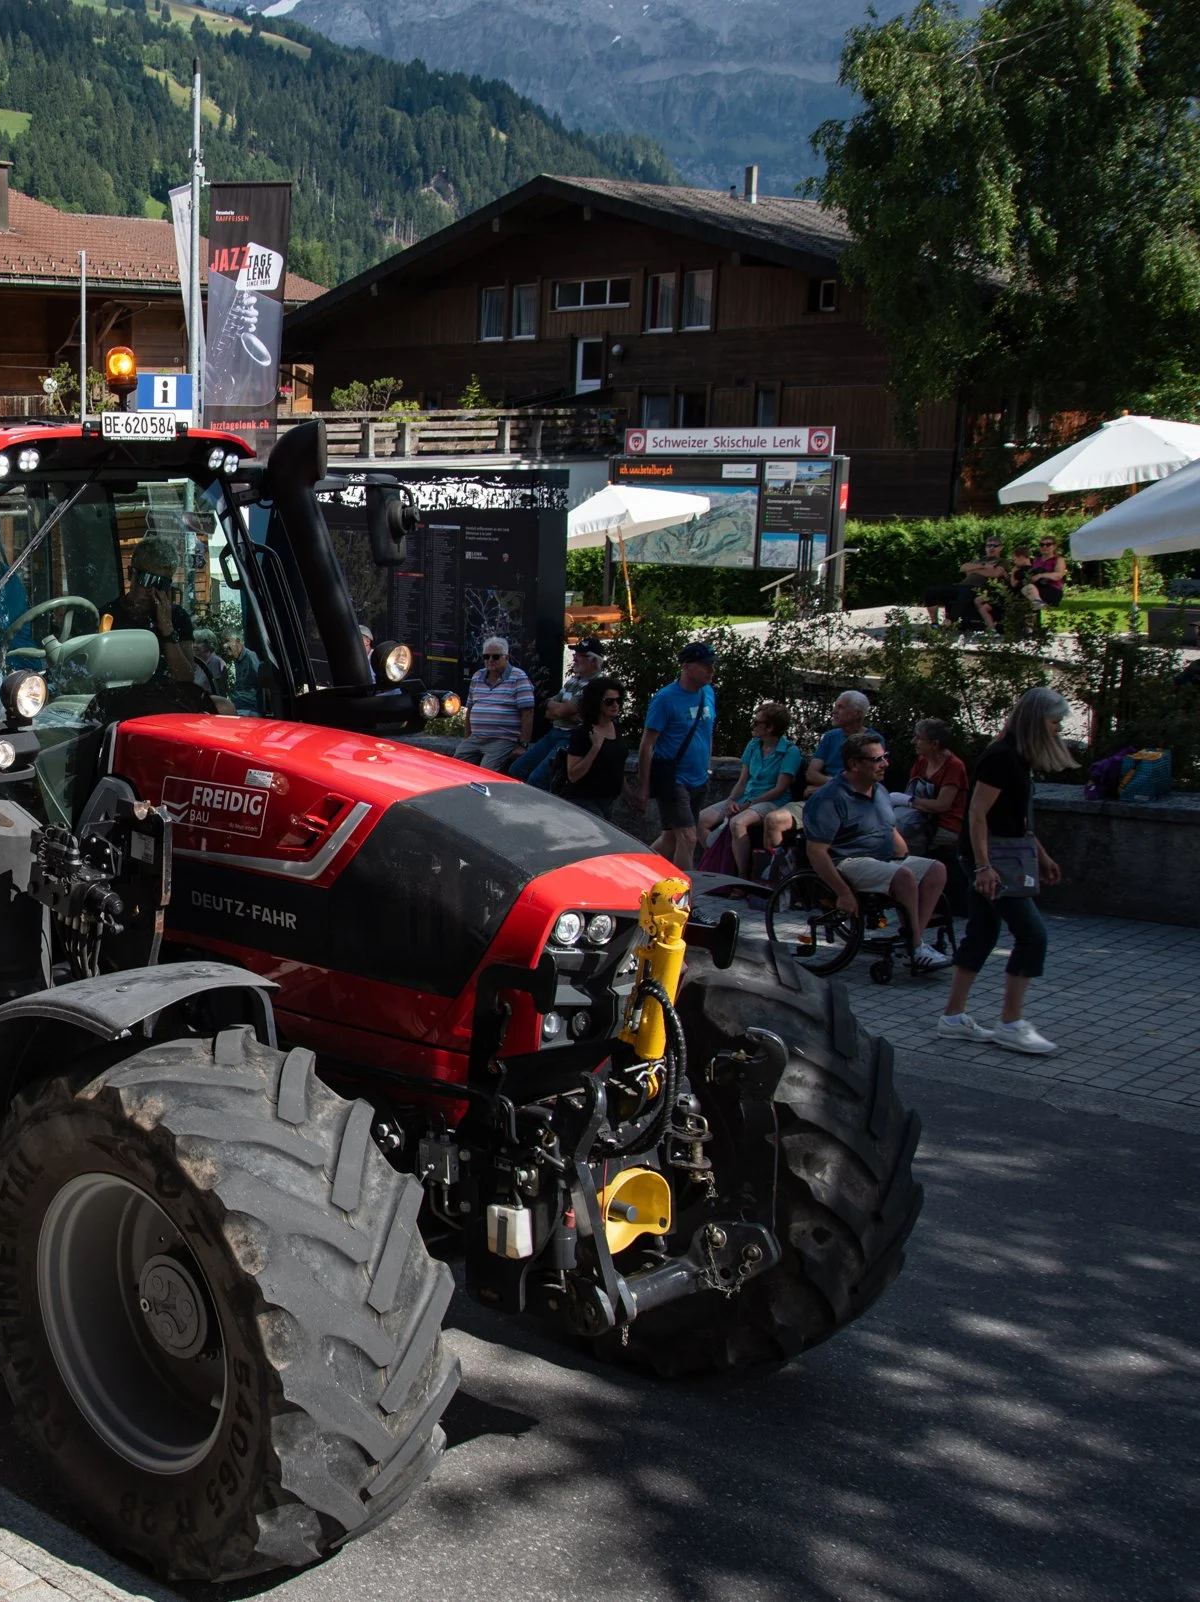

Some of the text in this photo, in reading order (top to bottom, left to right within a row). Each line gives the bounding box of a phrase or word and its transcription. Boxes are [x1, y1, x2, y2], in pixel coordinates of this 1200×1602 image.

[210, 246, 251, 273] JAZZ
[248, 253, 273, 268] TAGE
[246, 264, 272, 281] LENK
[210, 420, 270, 431] jazztagelenk.ch
[652, 434, 802, 448] Schweizer Skischule Lenk
[191, 786, 263, 816] FREIDIG
[189, 809, 210, 823] BAU
[191, 890, 297, 930] DEUTZ-FAHR
[206, 1356, 253, 1519] 540/65
